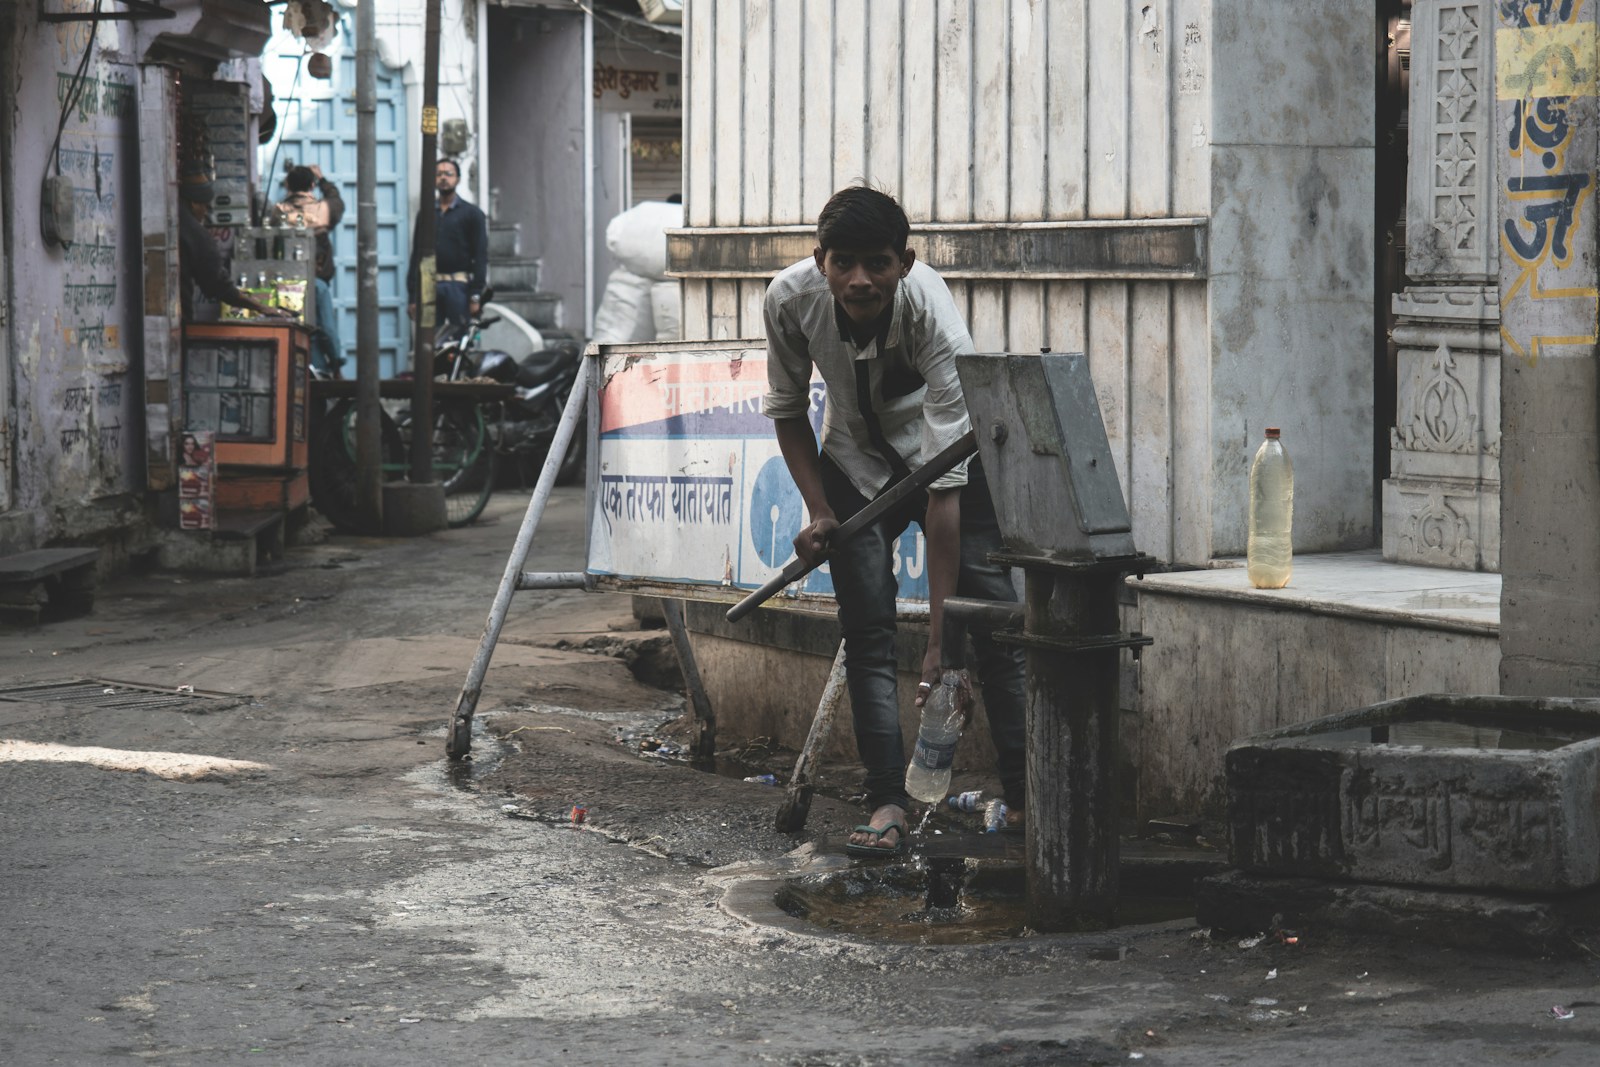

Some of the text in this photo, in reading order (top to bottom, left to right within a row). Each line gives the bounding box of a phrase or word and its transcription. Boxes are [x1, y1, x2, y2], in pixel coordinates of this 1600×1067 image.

[619, 69, 660, 99] कुमार
[657, 380, 767, 415] यातायात
[601, 475, 734, 537] एक तरफा यातायात
